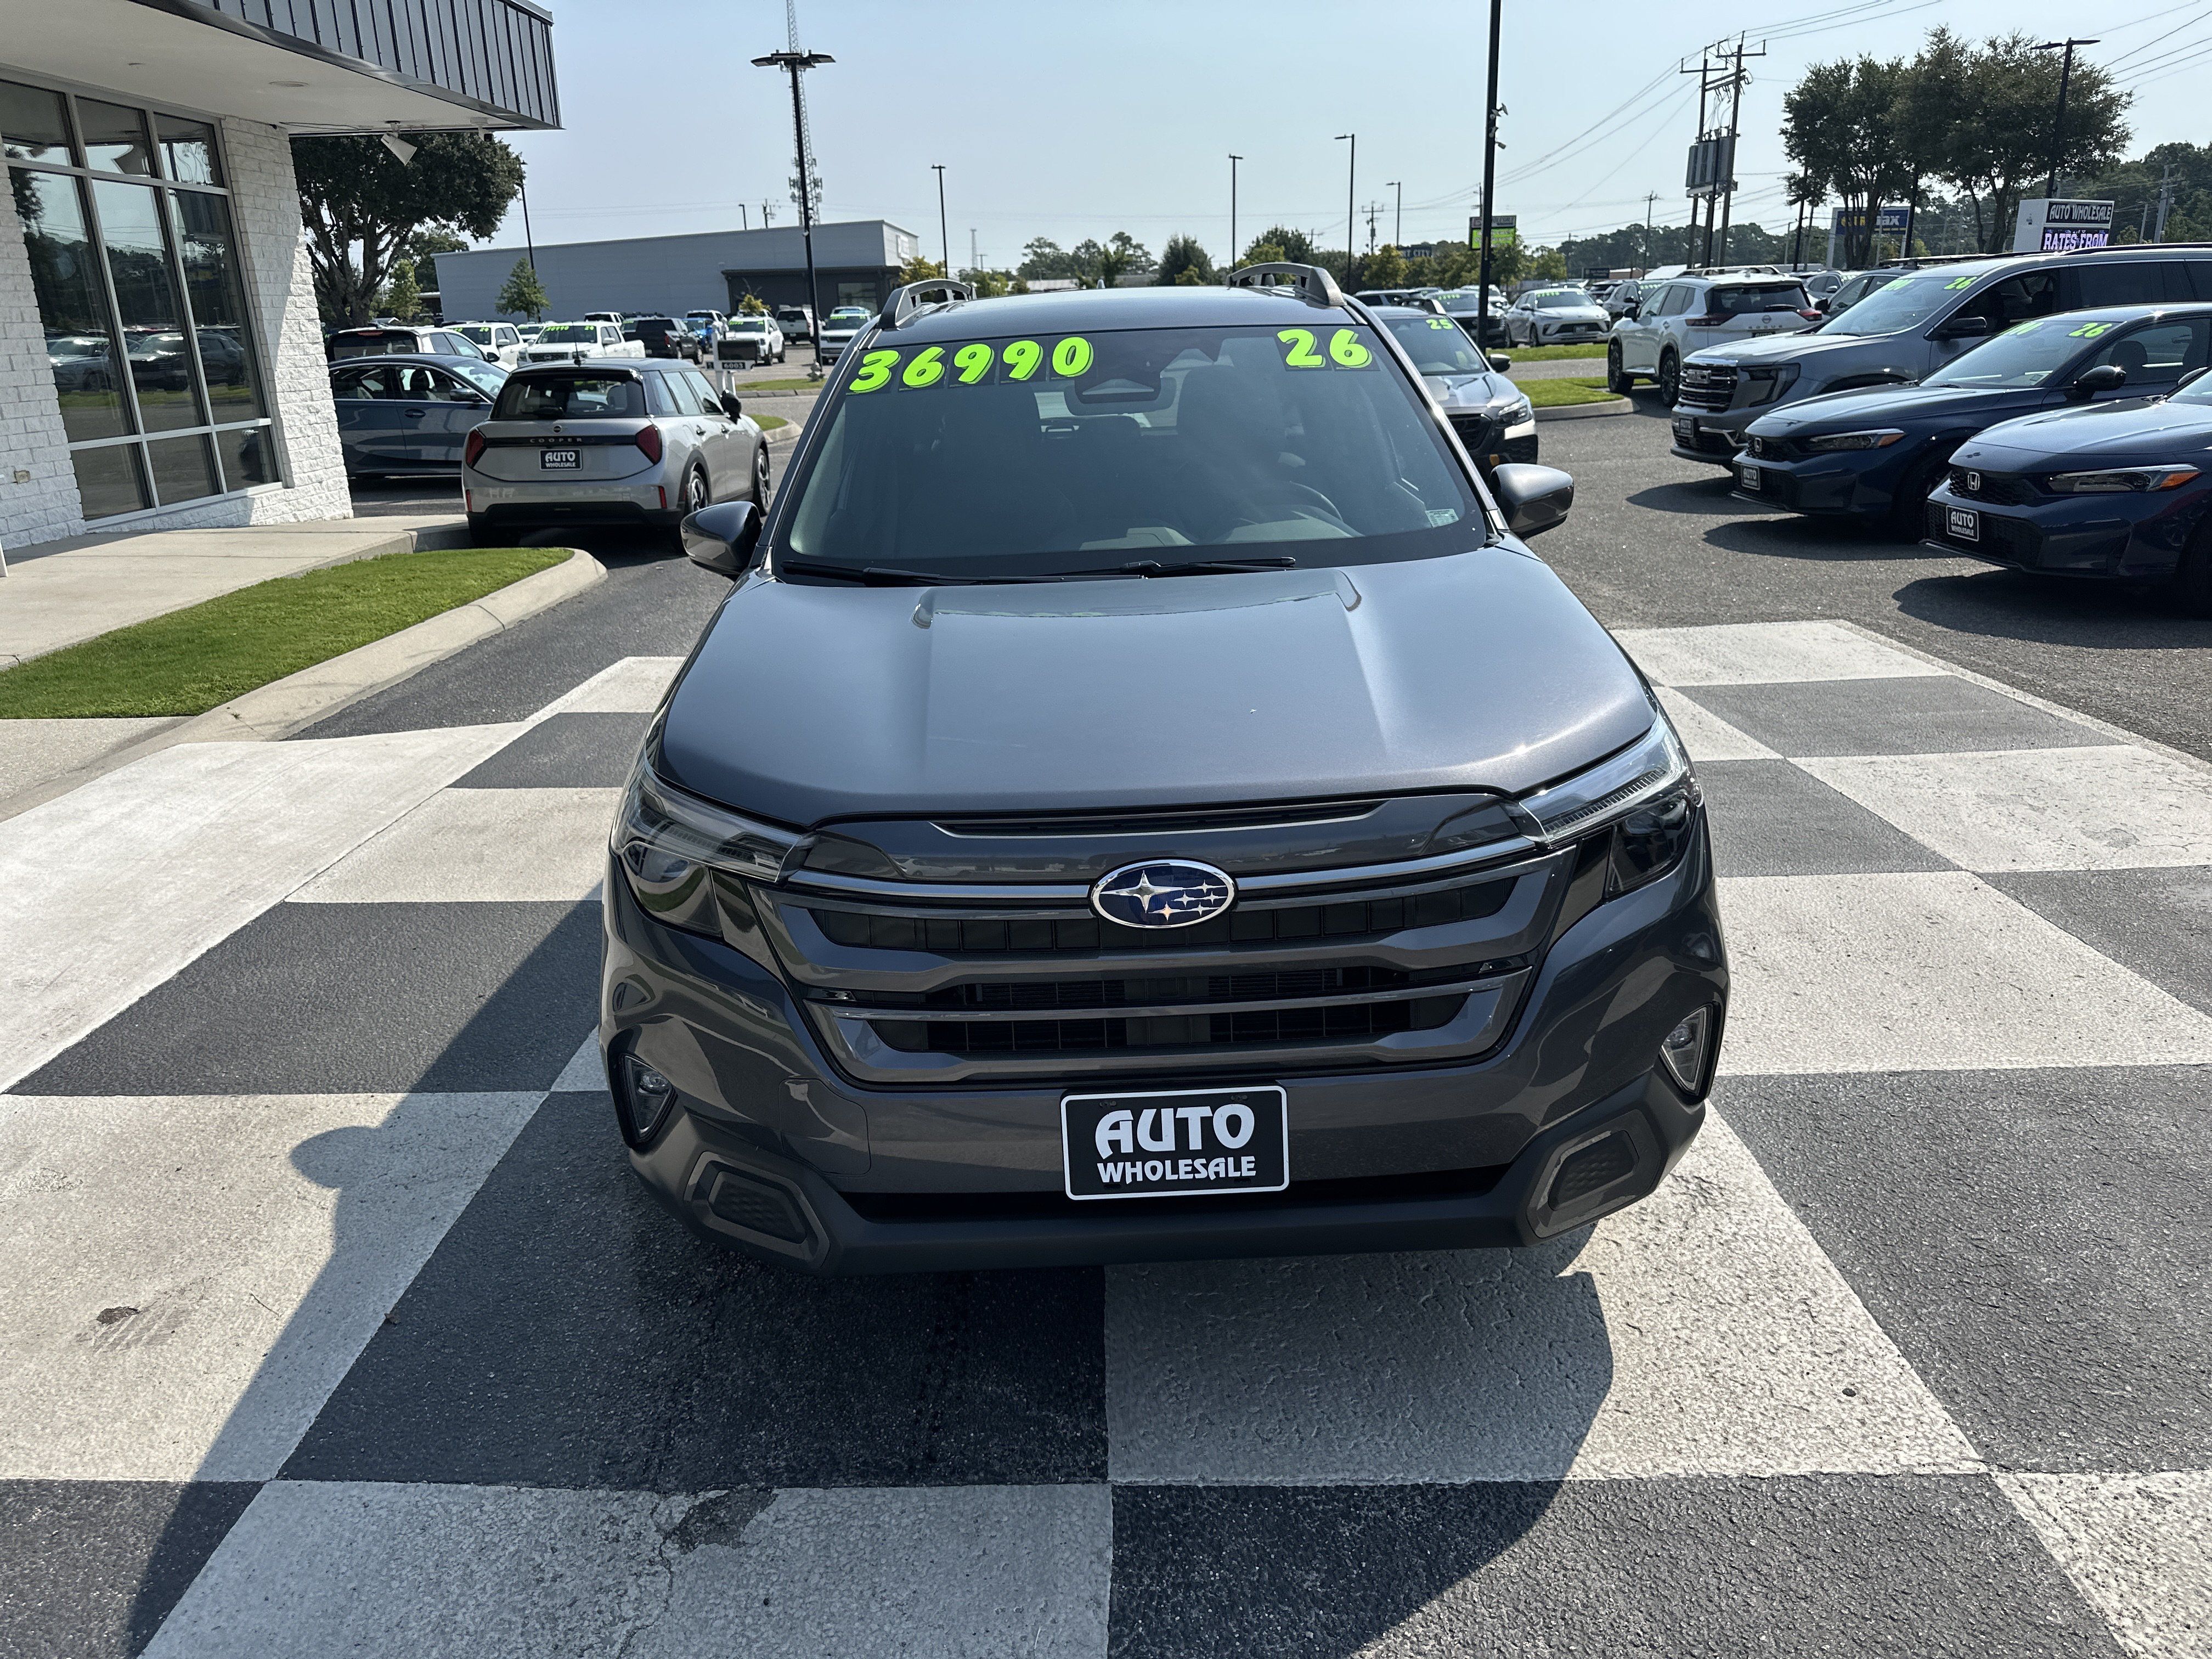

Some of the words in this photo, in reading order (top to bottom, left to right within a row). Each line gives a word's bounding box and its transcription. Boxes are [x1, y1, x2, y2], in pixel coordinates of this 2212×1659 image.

[2050, 205, 2070, 220] AUTO
[2072, 205, 2112, 221] WHOLESALE
[2043, 233, 2076, 250] RATES
[2079, 233, 2108, 249] FROM
[1944, 276, 1977, 290] 26
[1426, 319, 1454, 330] 25
[2068, 323, 2112, 338] 26
[849, 337, 1094, 393] 36990
[1277, 329, 1373, 368] 26
[545, 452, 575, 462] AUTO
[1951, 511, 1974, 528] AUTO
[1951, 524, 1974, 536] WHOLESALE
[1096, 1104, 1255, 1159] AUTO
[1097, 1156, 1256, 1184] WHOLESALE
